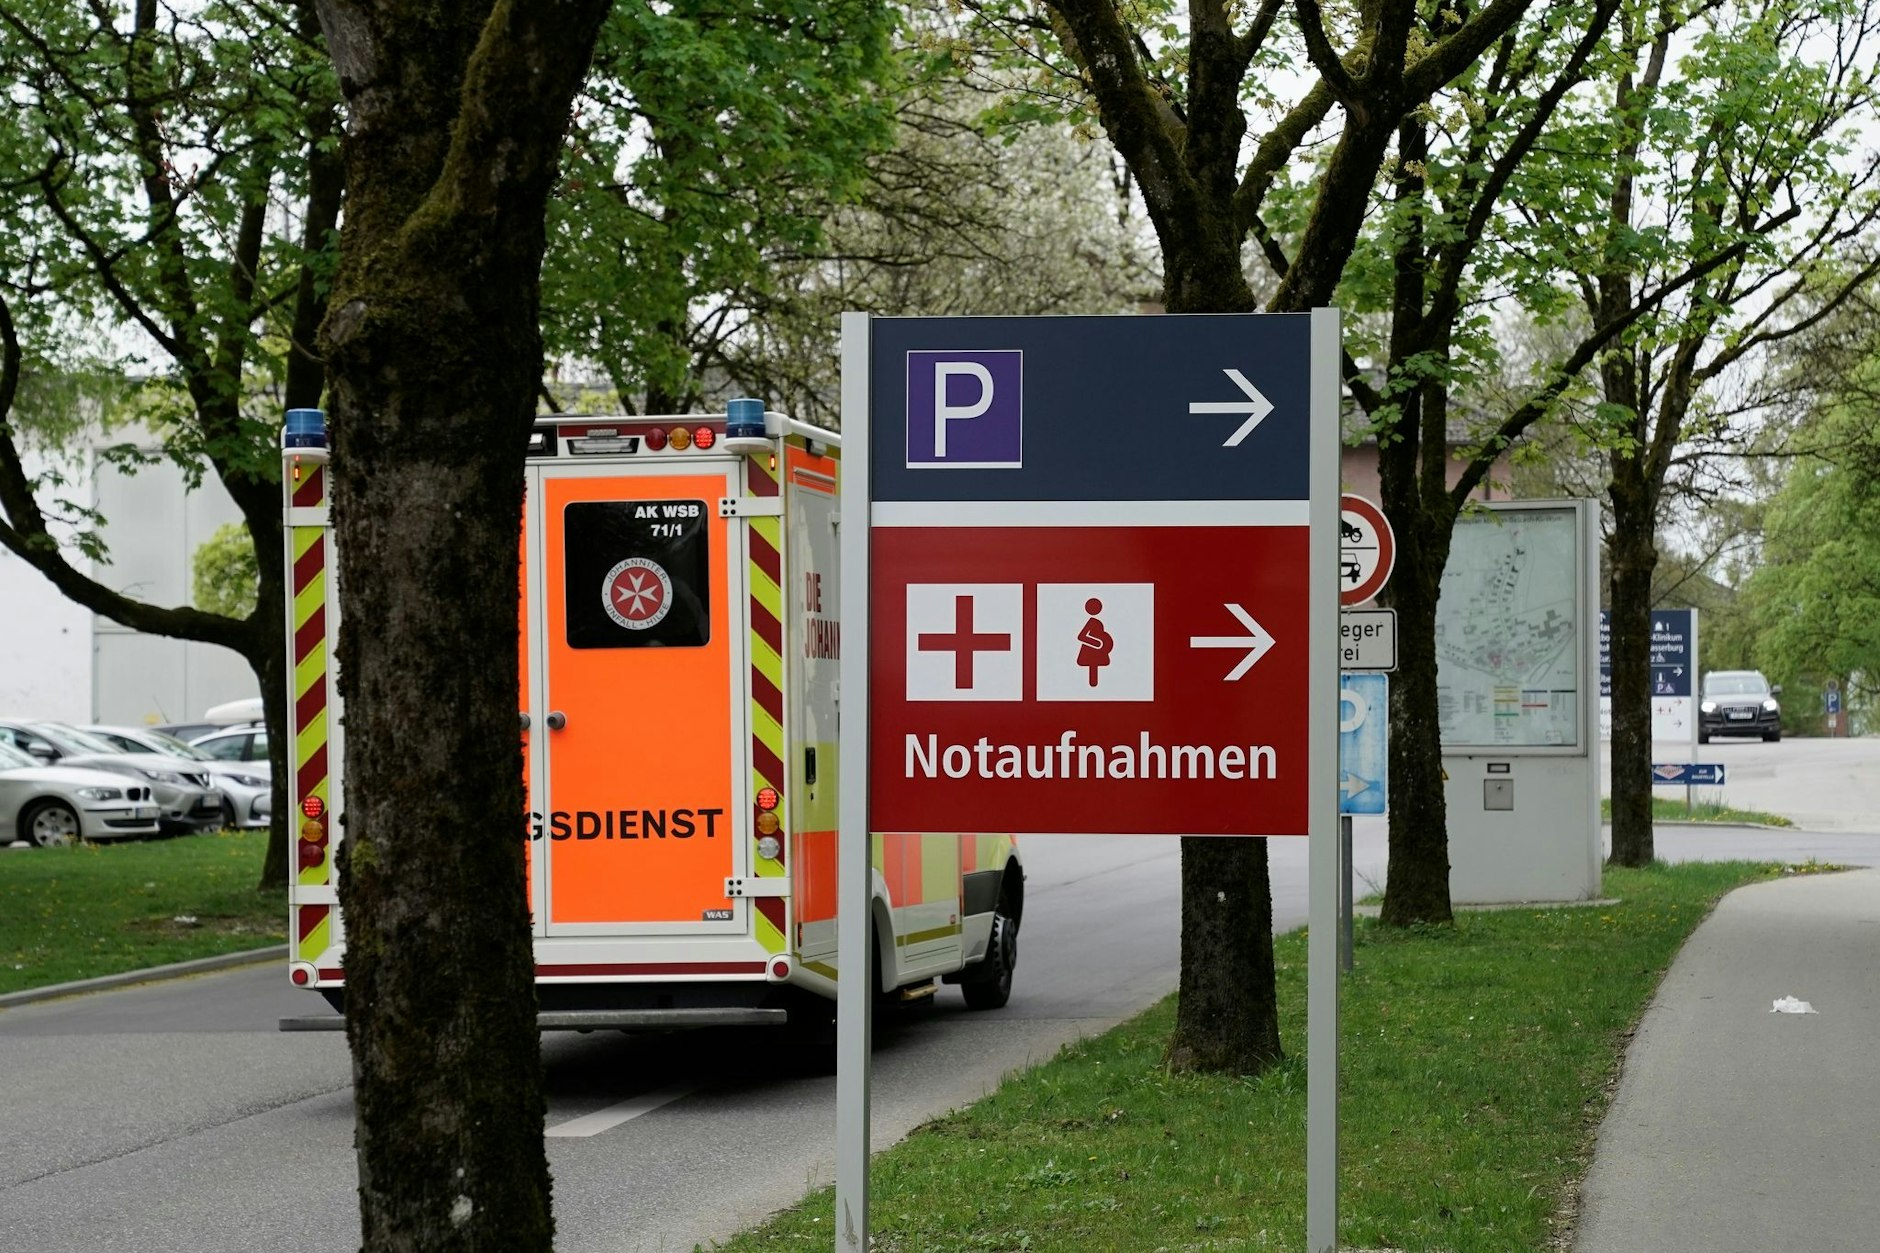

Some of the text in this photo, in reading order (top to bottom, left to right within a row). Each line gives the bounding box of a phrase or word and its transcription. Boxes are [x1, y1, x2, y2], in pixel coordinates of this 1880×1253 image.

[934, 361, 995, 458] P
[634, 505, 700, 519] AK WSB
[650, 523, 683, 538] 71/1
[805, 571, 822, 613] DIE
[1341, 643, 1360, 662] ei
[904, 729, 1278, 780] Notaufnahmen
[705, 909, 730, 920] WAS
